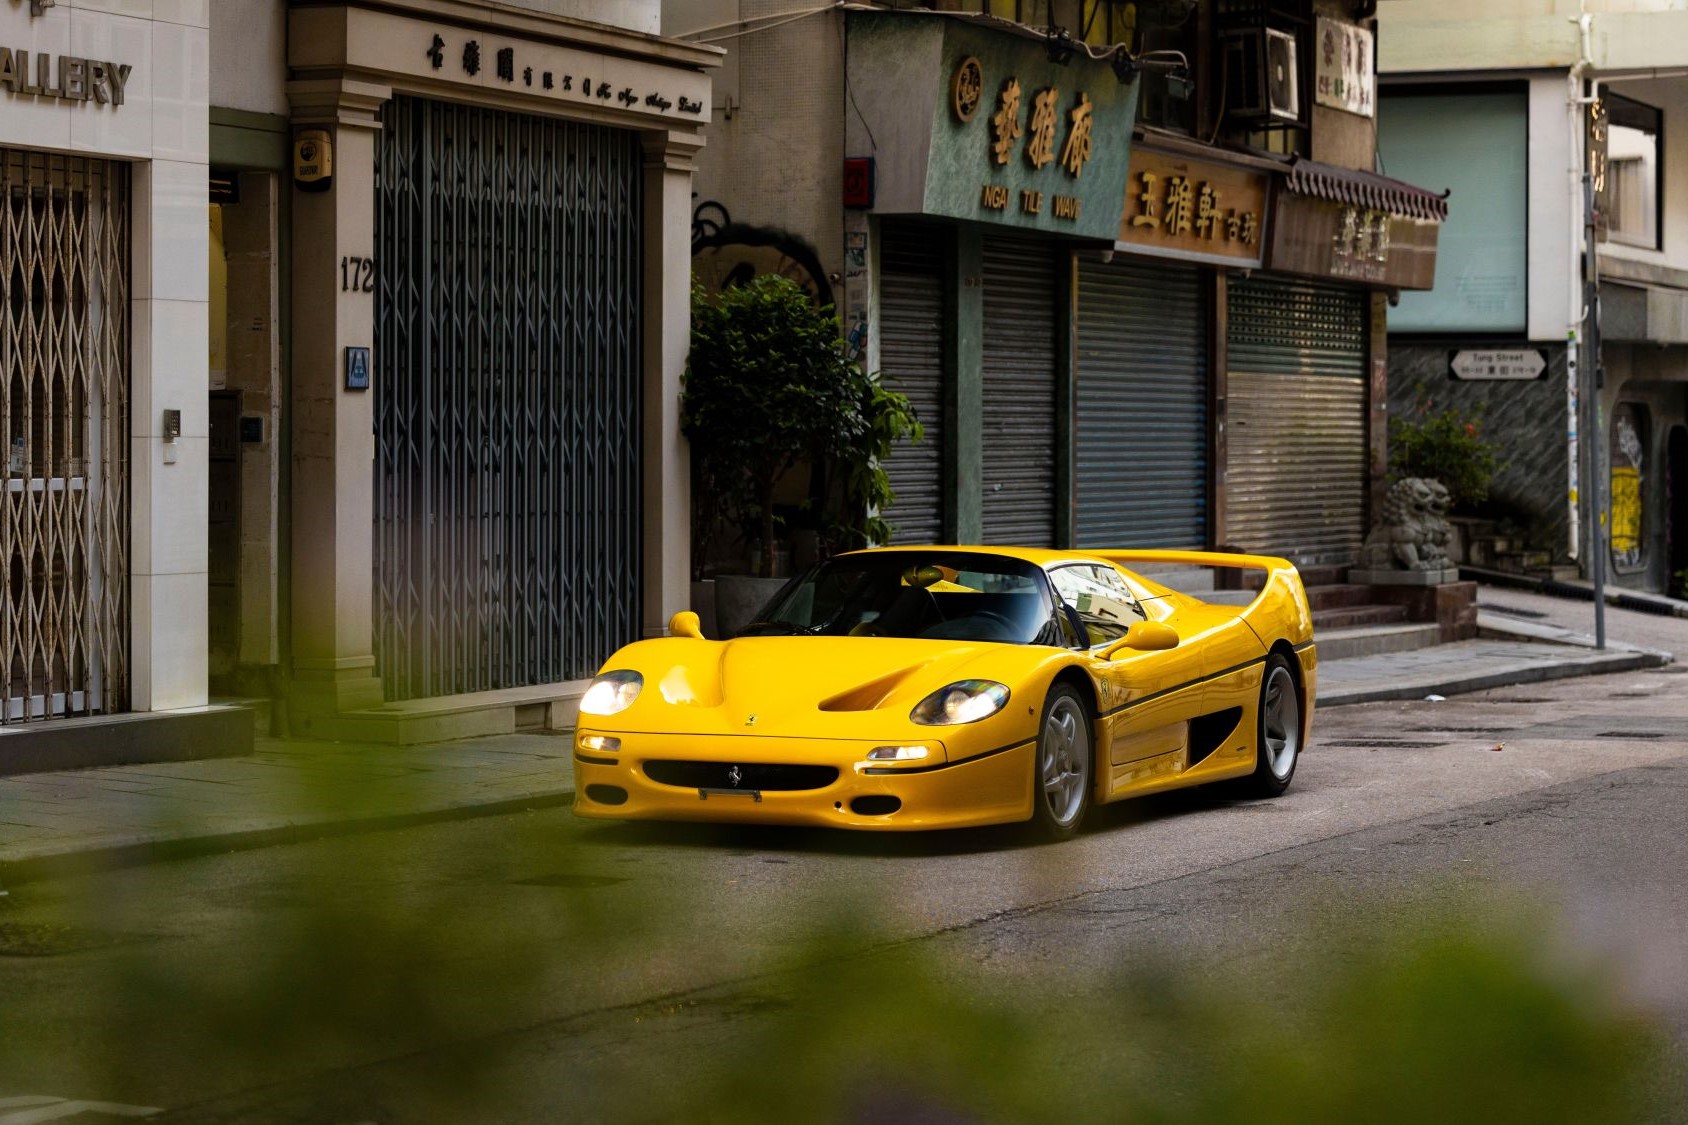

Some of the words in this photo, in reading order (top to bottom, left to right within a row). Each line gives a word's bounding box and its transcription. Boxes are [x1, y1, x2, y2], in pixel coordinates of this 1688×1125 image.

[983, 186, 1009, 208] NGAI
[1022, 190, 1045, 213] TILE
[341, 256, 374, 292] 172
[1473, 353, 1493, 363] Tung
[1496, 353, 1524, 362] Street
